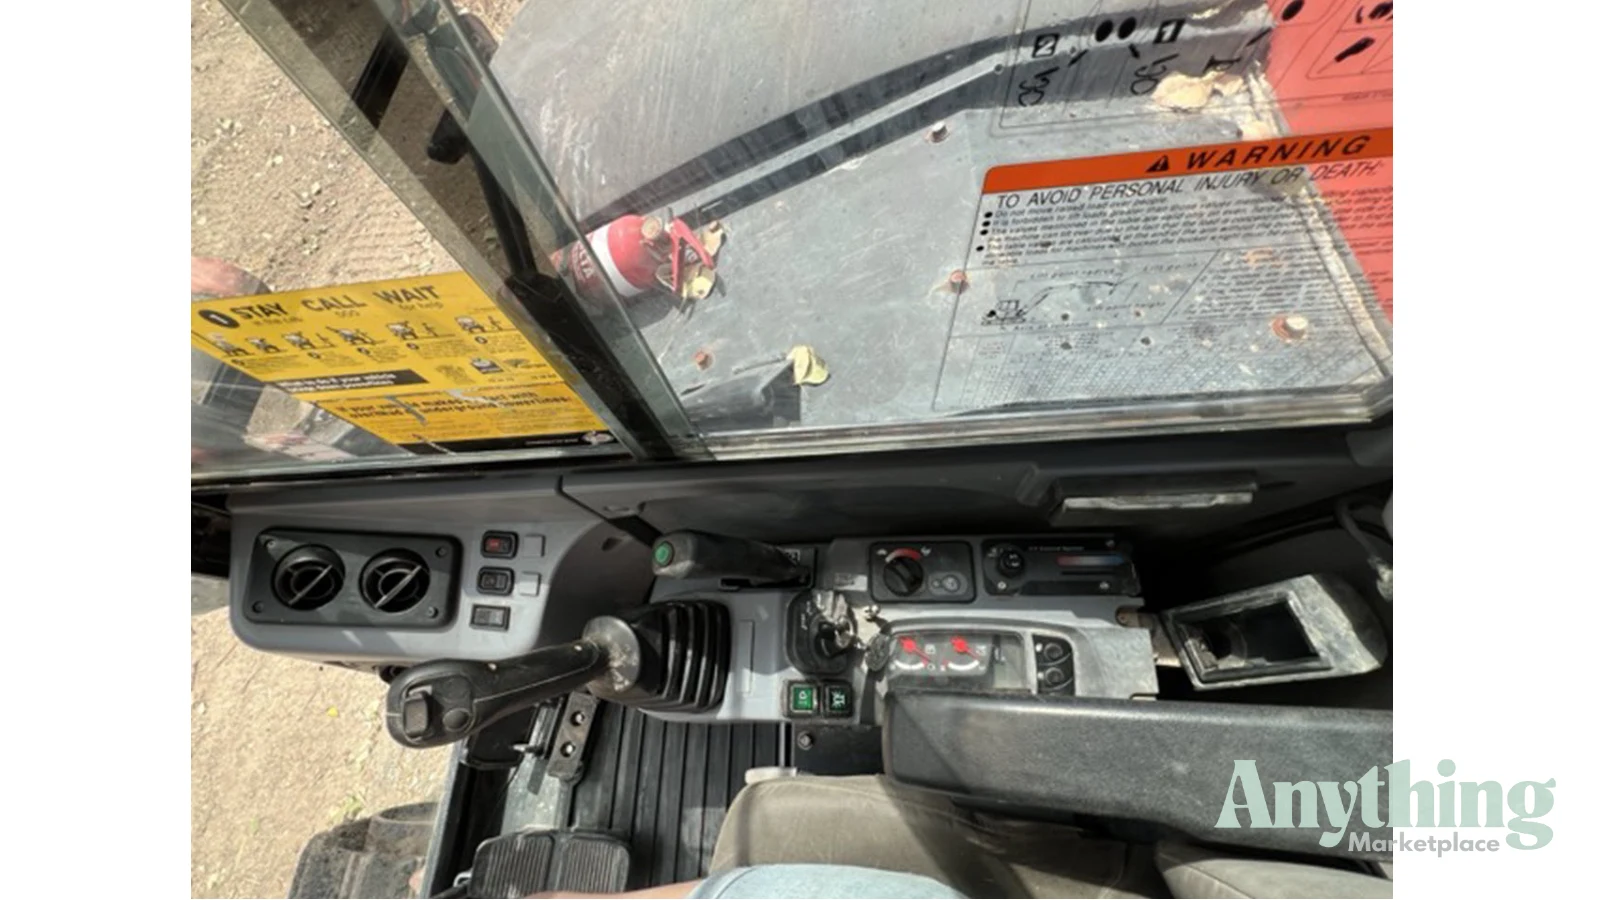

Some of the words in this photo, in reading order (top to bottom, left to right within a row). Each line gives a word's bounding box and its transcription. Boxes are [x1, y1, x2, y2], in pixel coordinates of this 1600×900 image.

[1186, 136, 1371, 170] WARNING
[998, 193, 1021, 209] TO
[1028, 187, 1081, 207] AVOID
[1088, 178, 1185, 201] PERSONAL
[1195, 168, 1264, 193] INJURY
[1269, 165, 1304, 185] OR
[302, 294, 368, 312] CALL
[372, 284, 440, 305] WAIT
[229, 302, 289, 320] STAY
